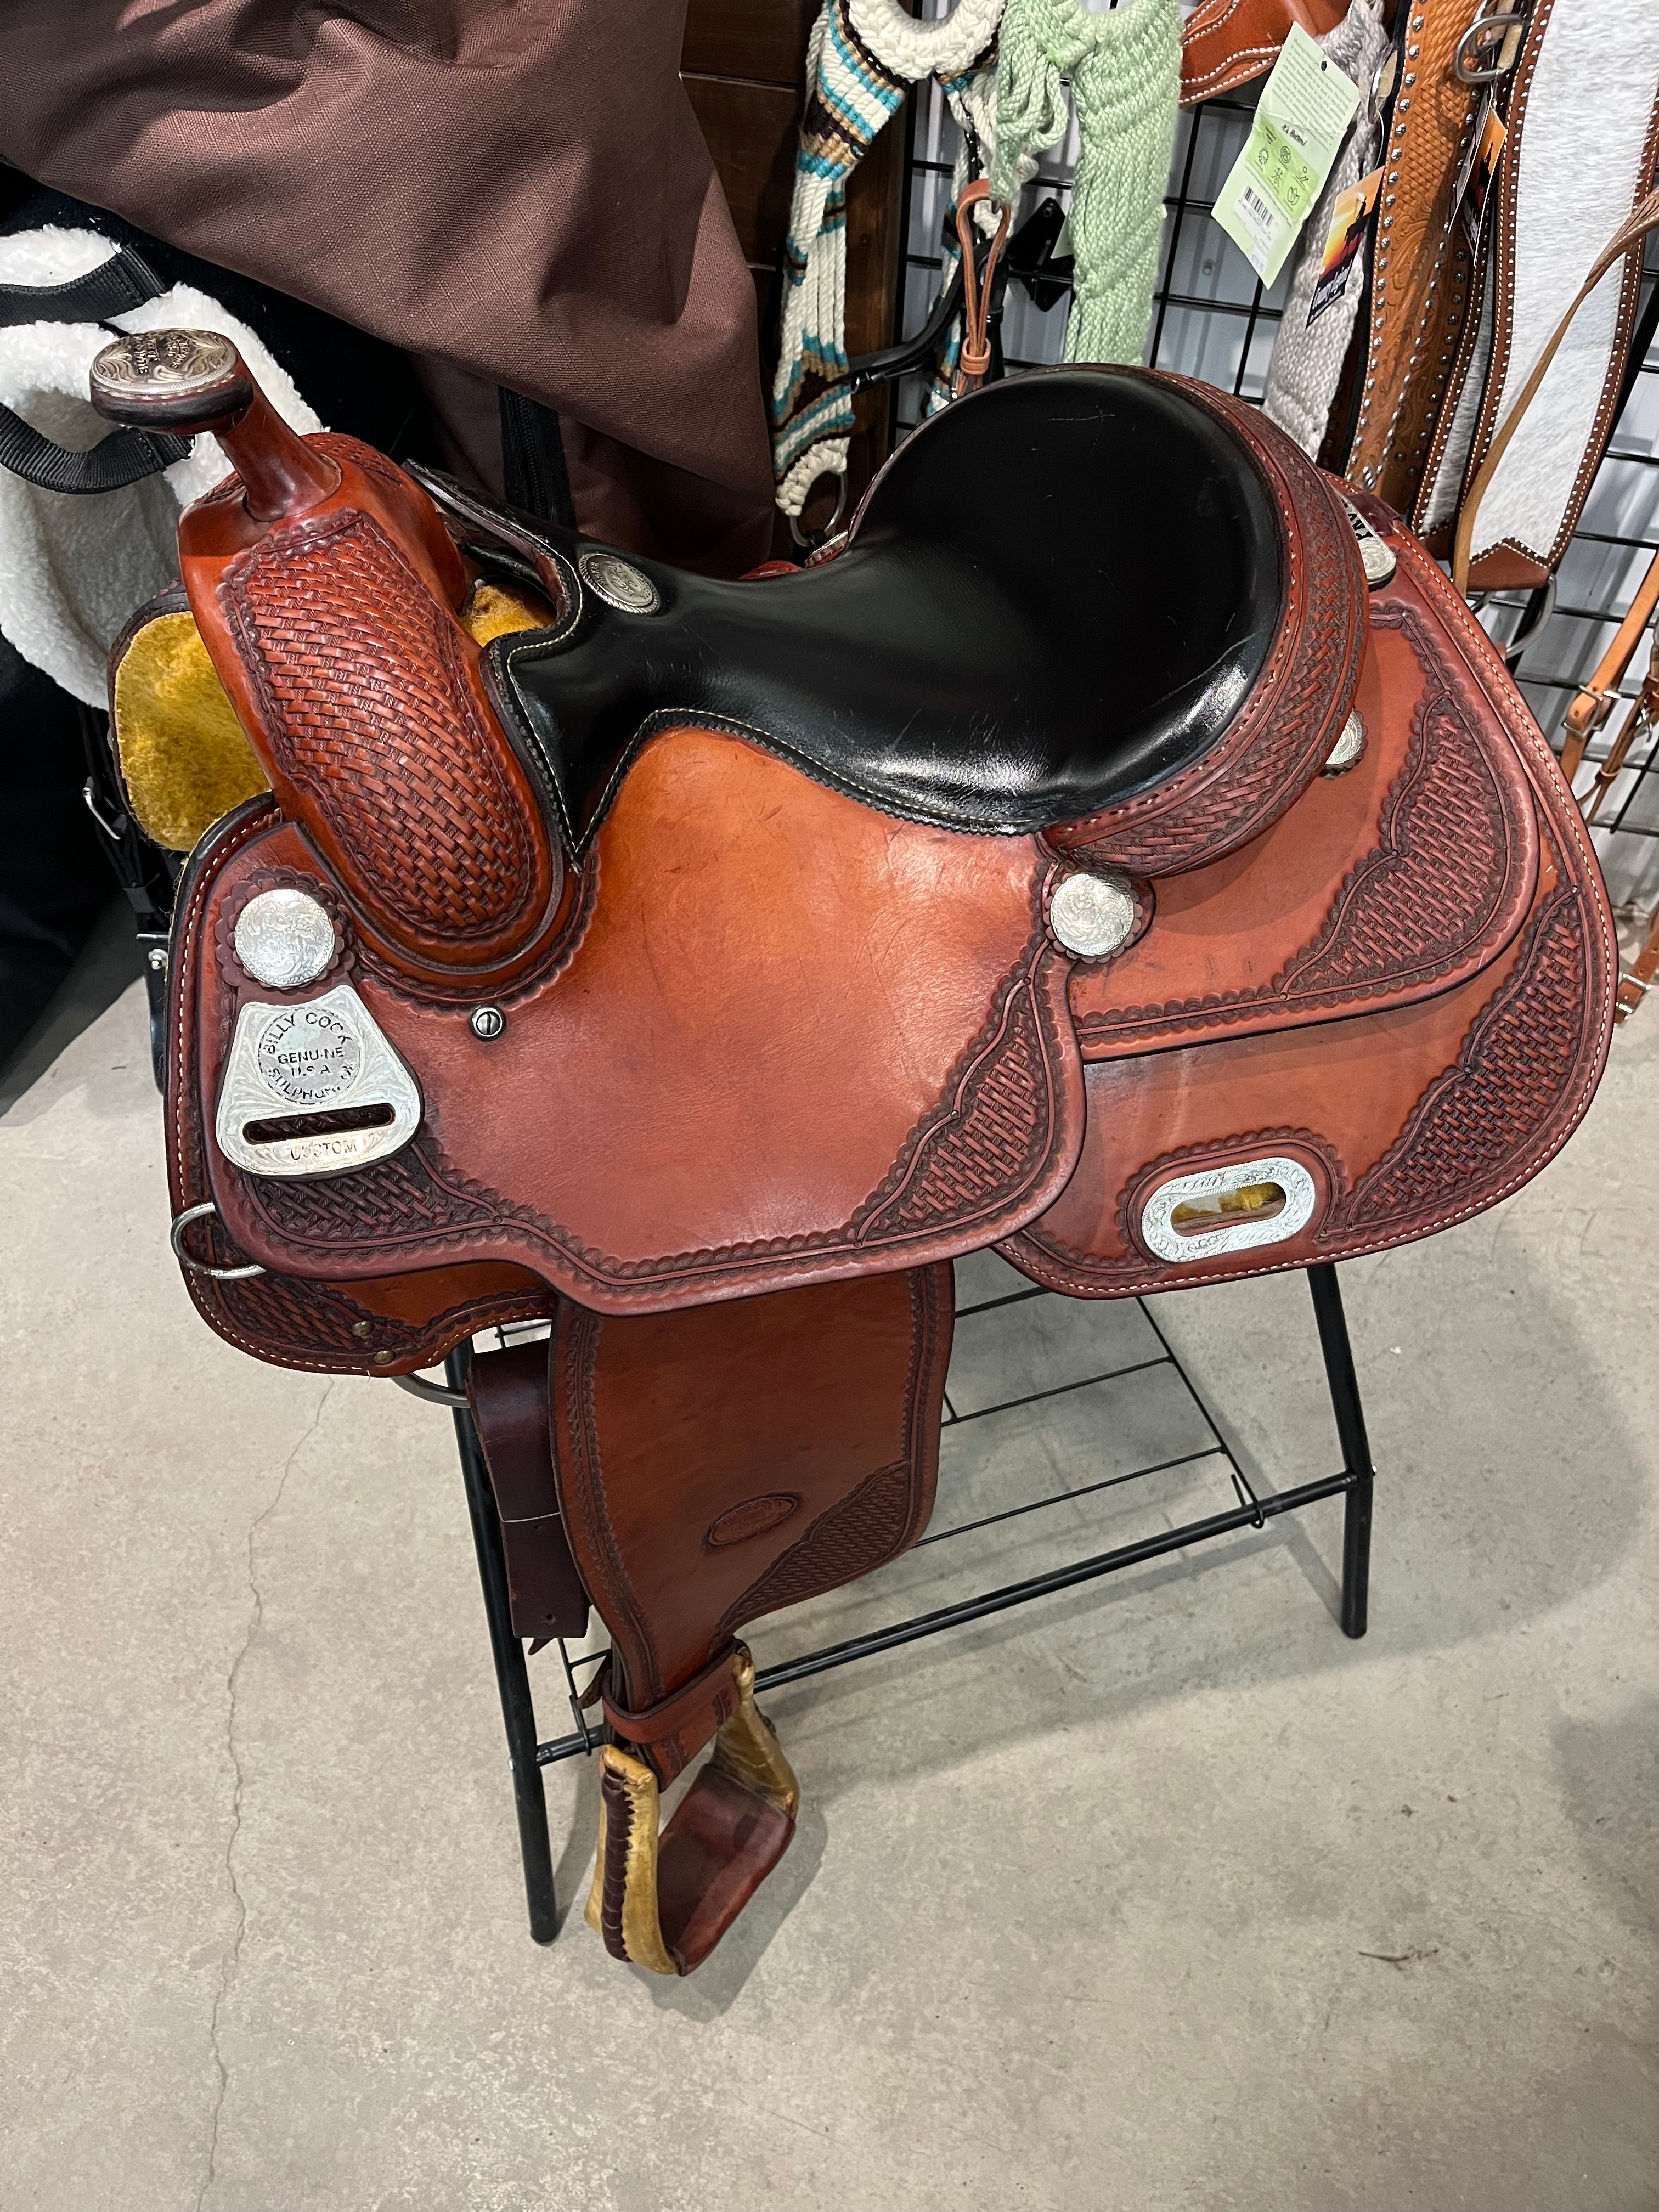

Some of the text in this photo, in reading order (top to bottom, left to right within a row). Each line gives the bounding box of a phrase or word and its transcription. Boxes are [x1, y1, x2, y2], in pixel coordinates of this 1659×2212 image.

[263, 1012, 353, 1055] BILLY COOK
[278, 1047, 345, 1064] GENUNE
[290, 1140, 357, 1161] CUSTOM
